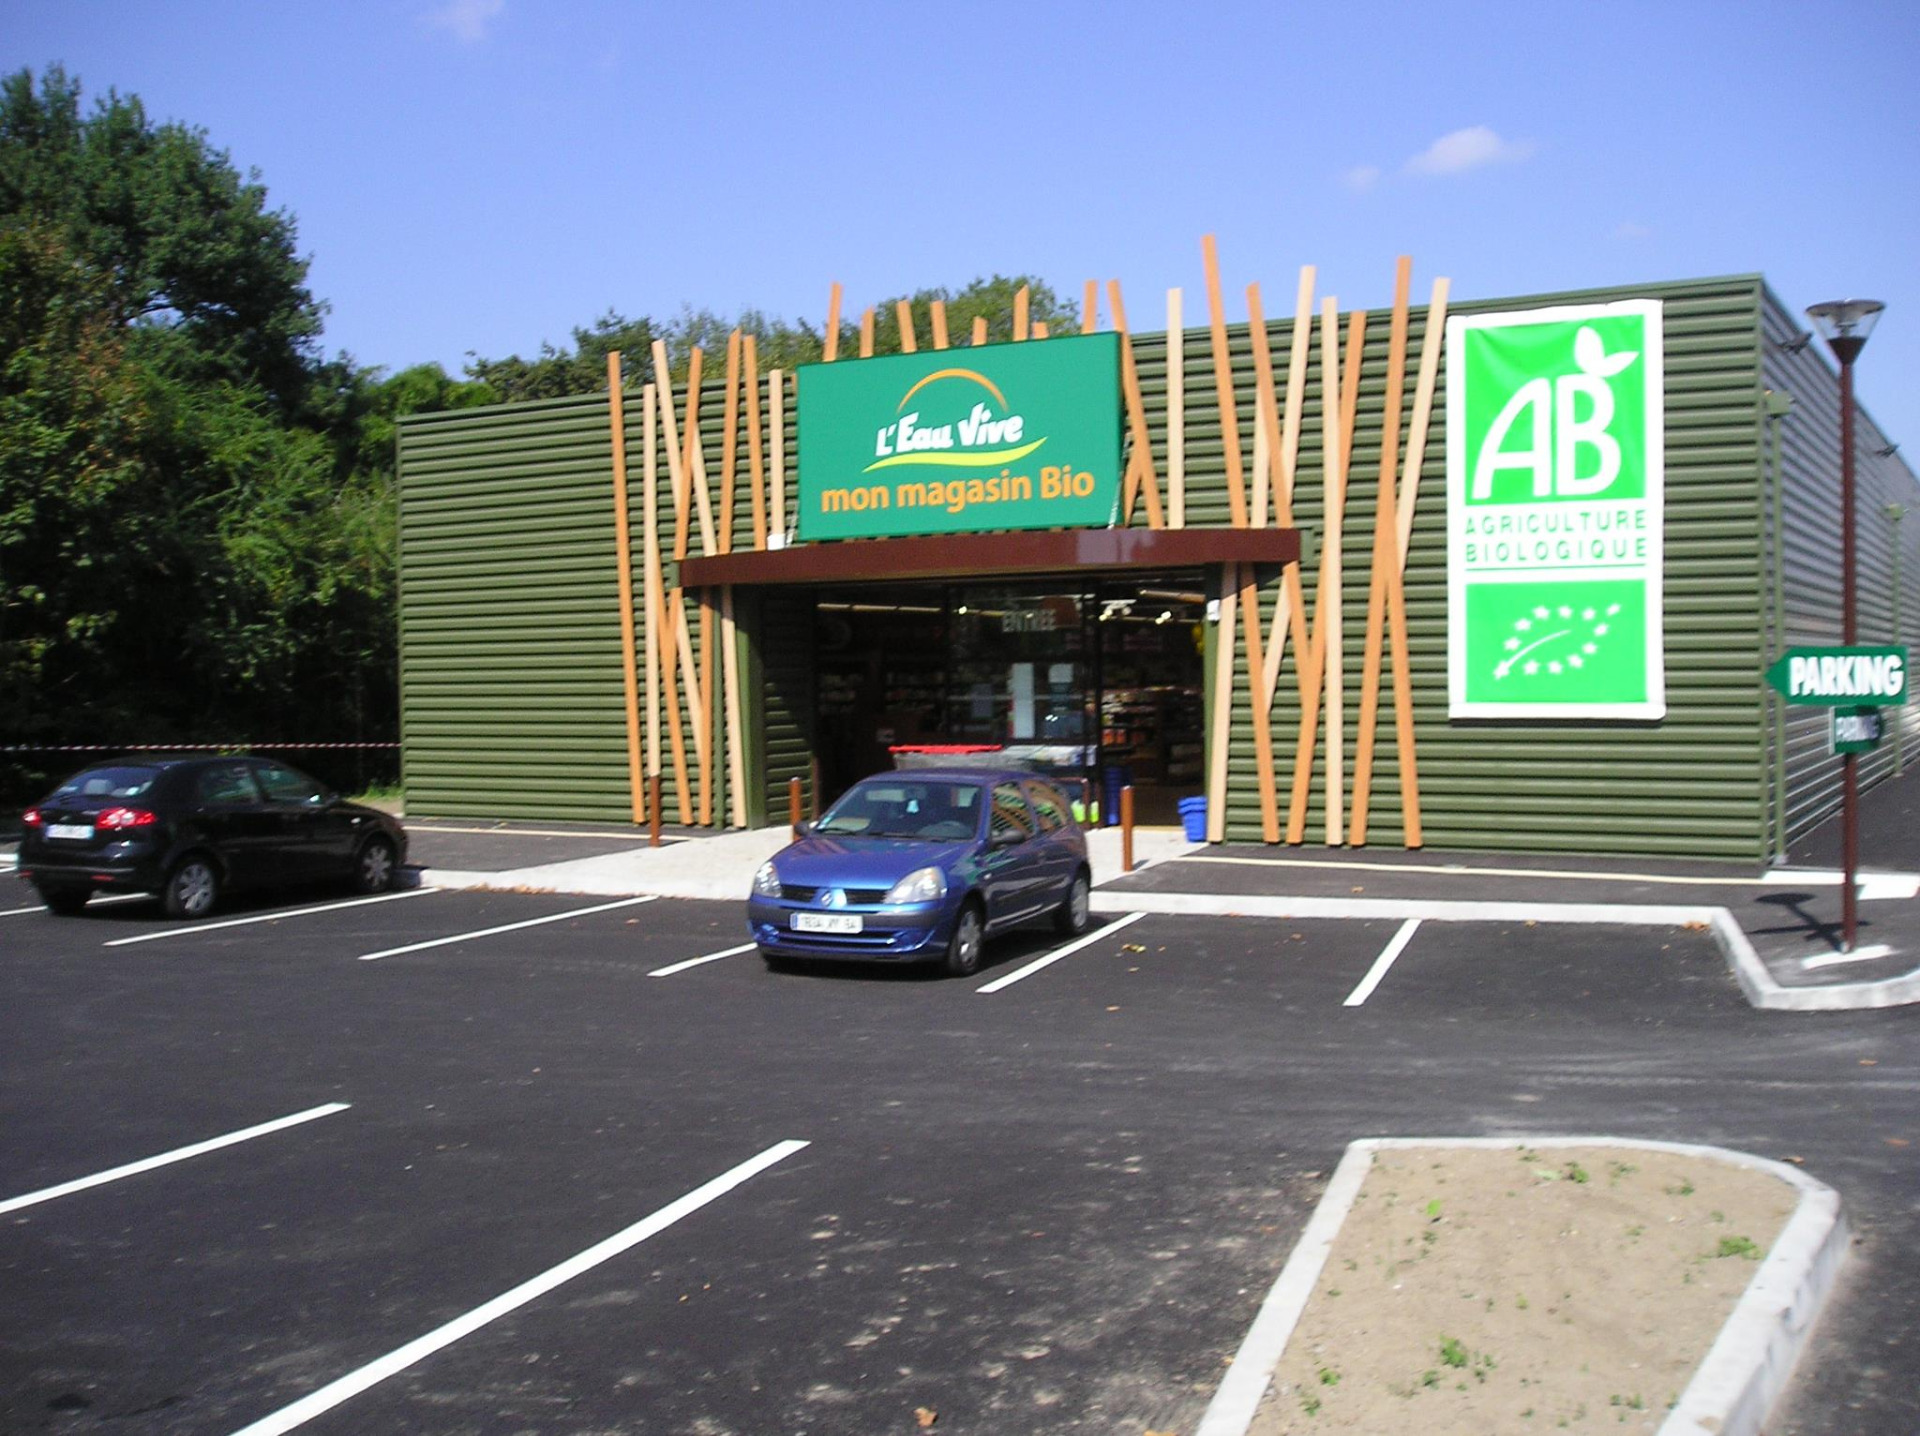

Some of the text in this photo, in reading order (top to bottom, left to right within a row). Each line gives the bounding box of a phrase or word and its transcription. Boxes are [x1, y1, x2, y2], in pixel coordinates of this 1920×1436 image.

[876, 402, 1023, 456] L'Eau Vive
[1472, 374, 1621, 499] AB
[821, 464, 1095, 513] mon magasin Bio
[1465, 509, 1647, 536] AGRICULTURE
[1465, 537, 1647, 564] BIOLOGIQUE
[1789, 654, 1905, 697] PARKING
